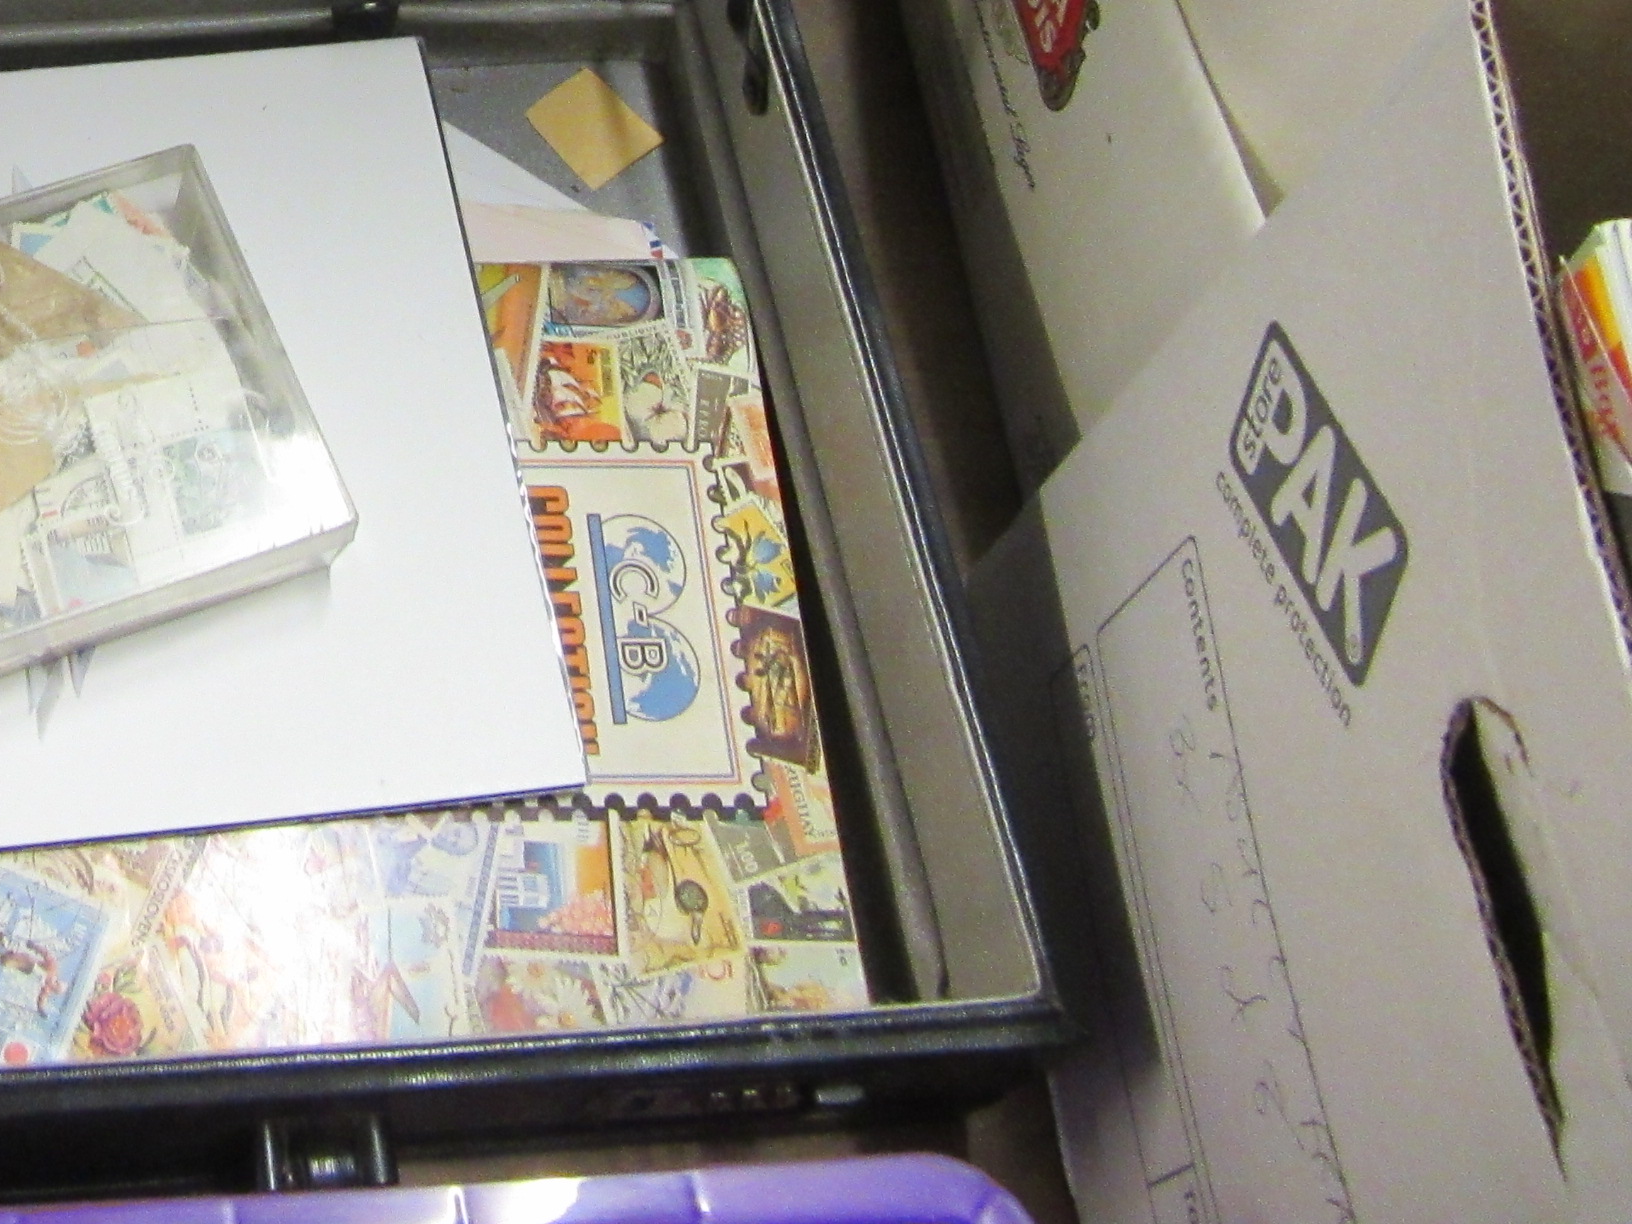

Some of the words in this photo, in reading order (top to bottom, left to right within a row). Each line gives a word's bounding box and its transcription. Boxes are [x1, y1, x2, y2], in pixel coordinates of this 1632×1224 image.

[1242, 356, 1284, 461] store
[1261, 340, 1397, 665] PAK
[609, 561, 668, 680] C-B
[1180, 558, 1221, 714] Contents
[1214, 471, 1275, 585] complete
[1273, 583, 1354, 728] protection
